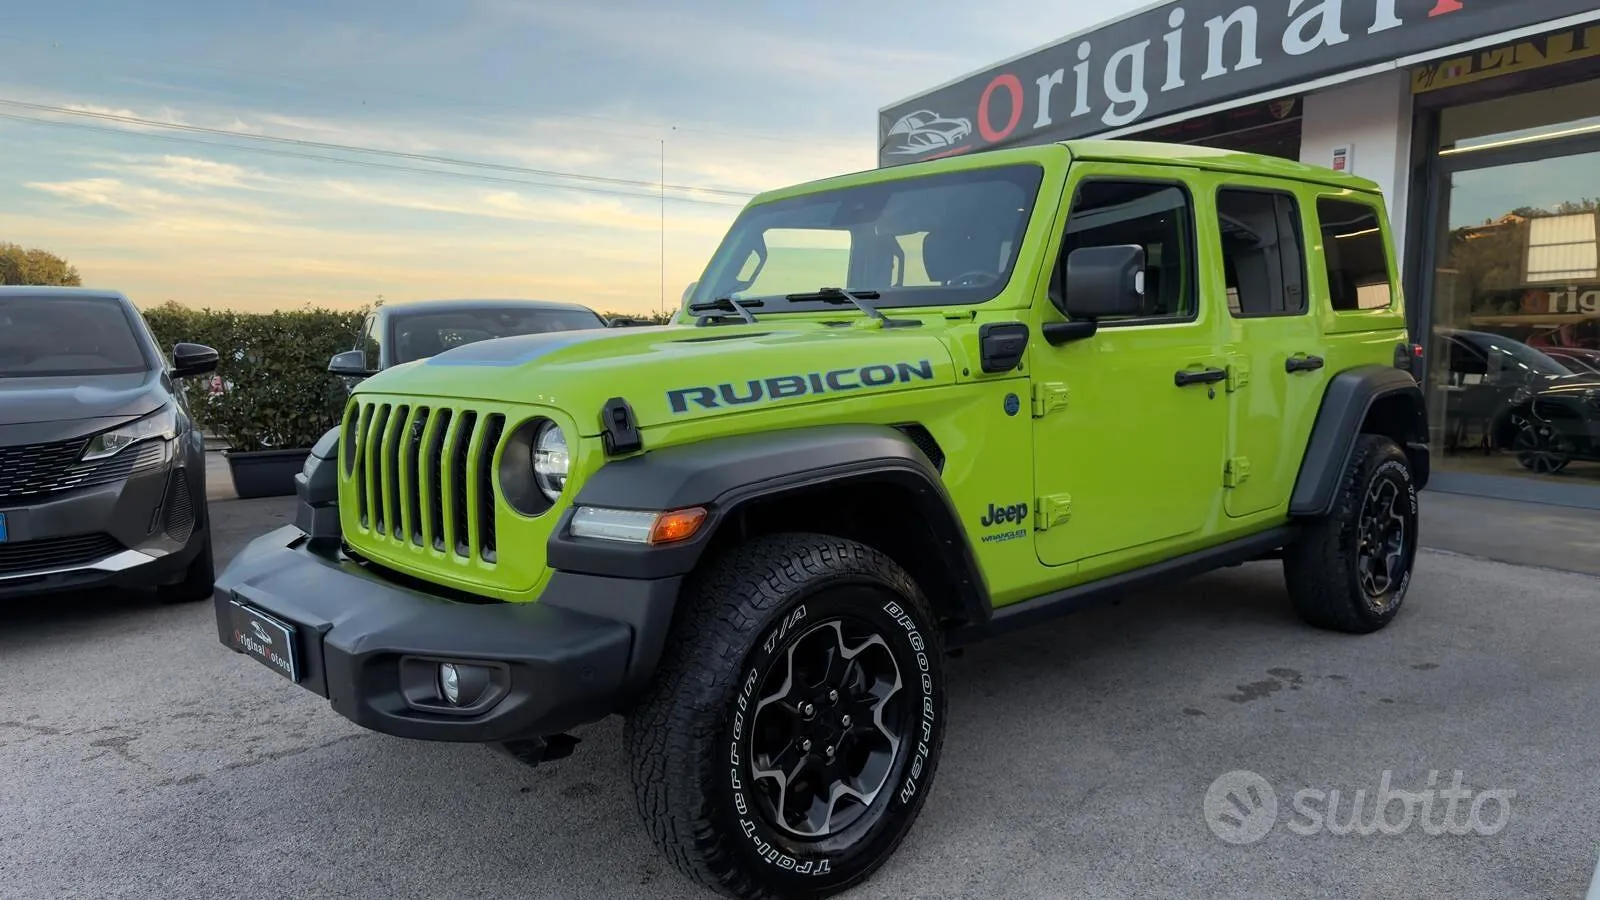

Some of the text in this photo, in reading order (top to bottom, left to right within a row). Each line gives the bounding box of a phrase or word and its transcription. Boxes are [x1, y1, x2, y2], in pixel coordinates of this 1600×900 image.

[665, 359, 934, 415] RUBICON
[981, 502, 1028, 527] Jeep
[764, 604, 807, 655] T/A
[883, 601, 935, 804] BFGoodrich
